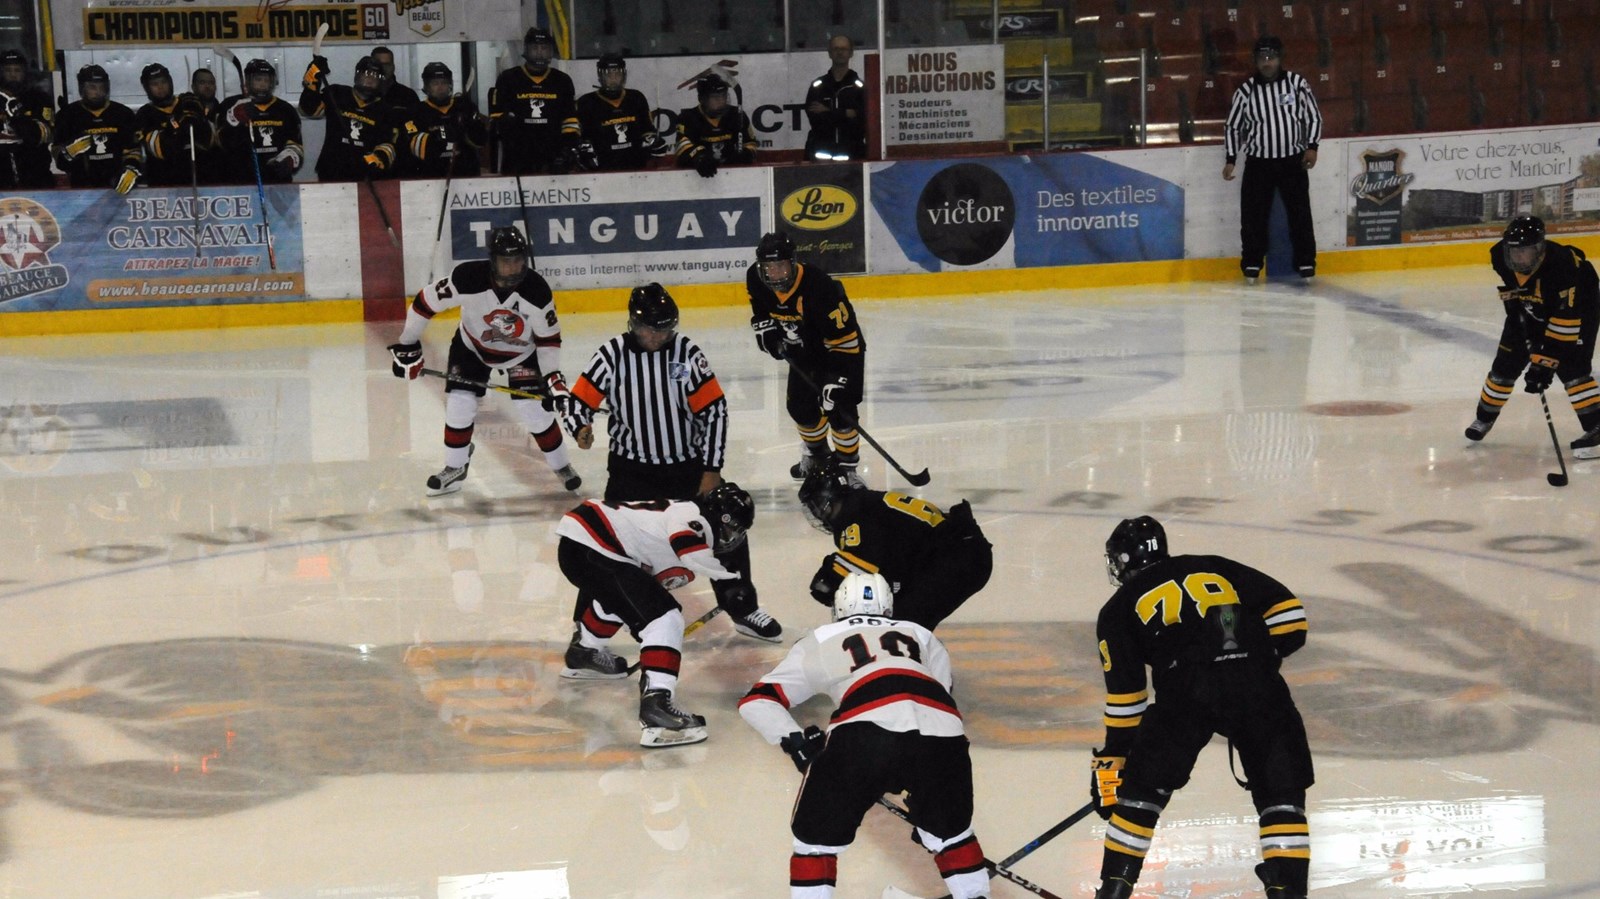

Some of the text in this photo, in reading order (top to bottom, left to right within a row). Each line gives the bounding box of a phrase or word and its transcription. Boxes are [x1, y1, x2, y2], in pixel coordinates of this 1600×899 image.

[88, 11, 239, 41] CHAMPIONS
[246, 23, 263, 39] DU
[269, 8, 358, 38] MONDE
[365, 7, 385, 27] 60
[412, 12, 440, 21] BEAUCE
[908, 52, 957, 73] NOUS
[885, 71, 996, 94] MBAUCHONS
[899, 98, 952, 108] Soudeurs
[899, 108, 967, 119] Machinistes
[899, 119, 970, 130] Mécaniciens
[899, 129, 974, 141] Dessinateurs
[1420, 140, 1565, 162] Votre chez-vous,
[1456, 163, 1502, 181] votre
[450, 188, 591, 208] AMEUBLEMENTS
[1037, 185, 1157, 208] Des textiles
[127, 195, 253, 222] BEAUCE
[926, 198, 1005, 225] victor
[1037, 211, 1139, 232] innovants
[108, 222, 275, 250] CARNAVAL
[124, 258, 190, 271] ATTRAPEZ
[192, 257, 208, 269] LA
[537, 258, 748, 277] otre site Internet: www.tanguay.ca
[0, 276, 62, 298] ARNAVAL
[99, 279, 294, 298] www.beaucecarnaval.com
[512, 301, 520, 312] A
[842, 630, 922, 674] 10
